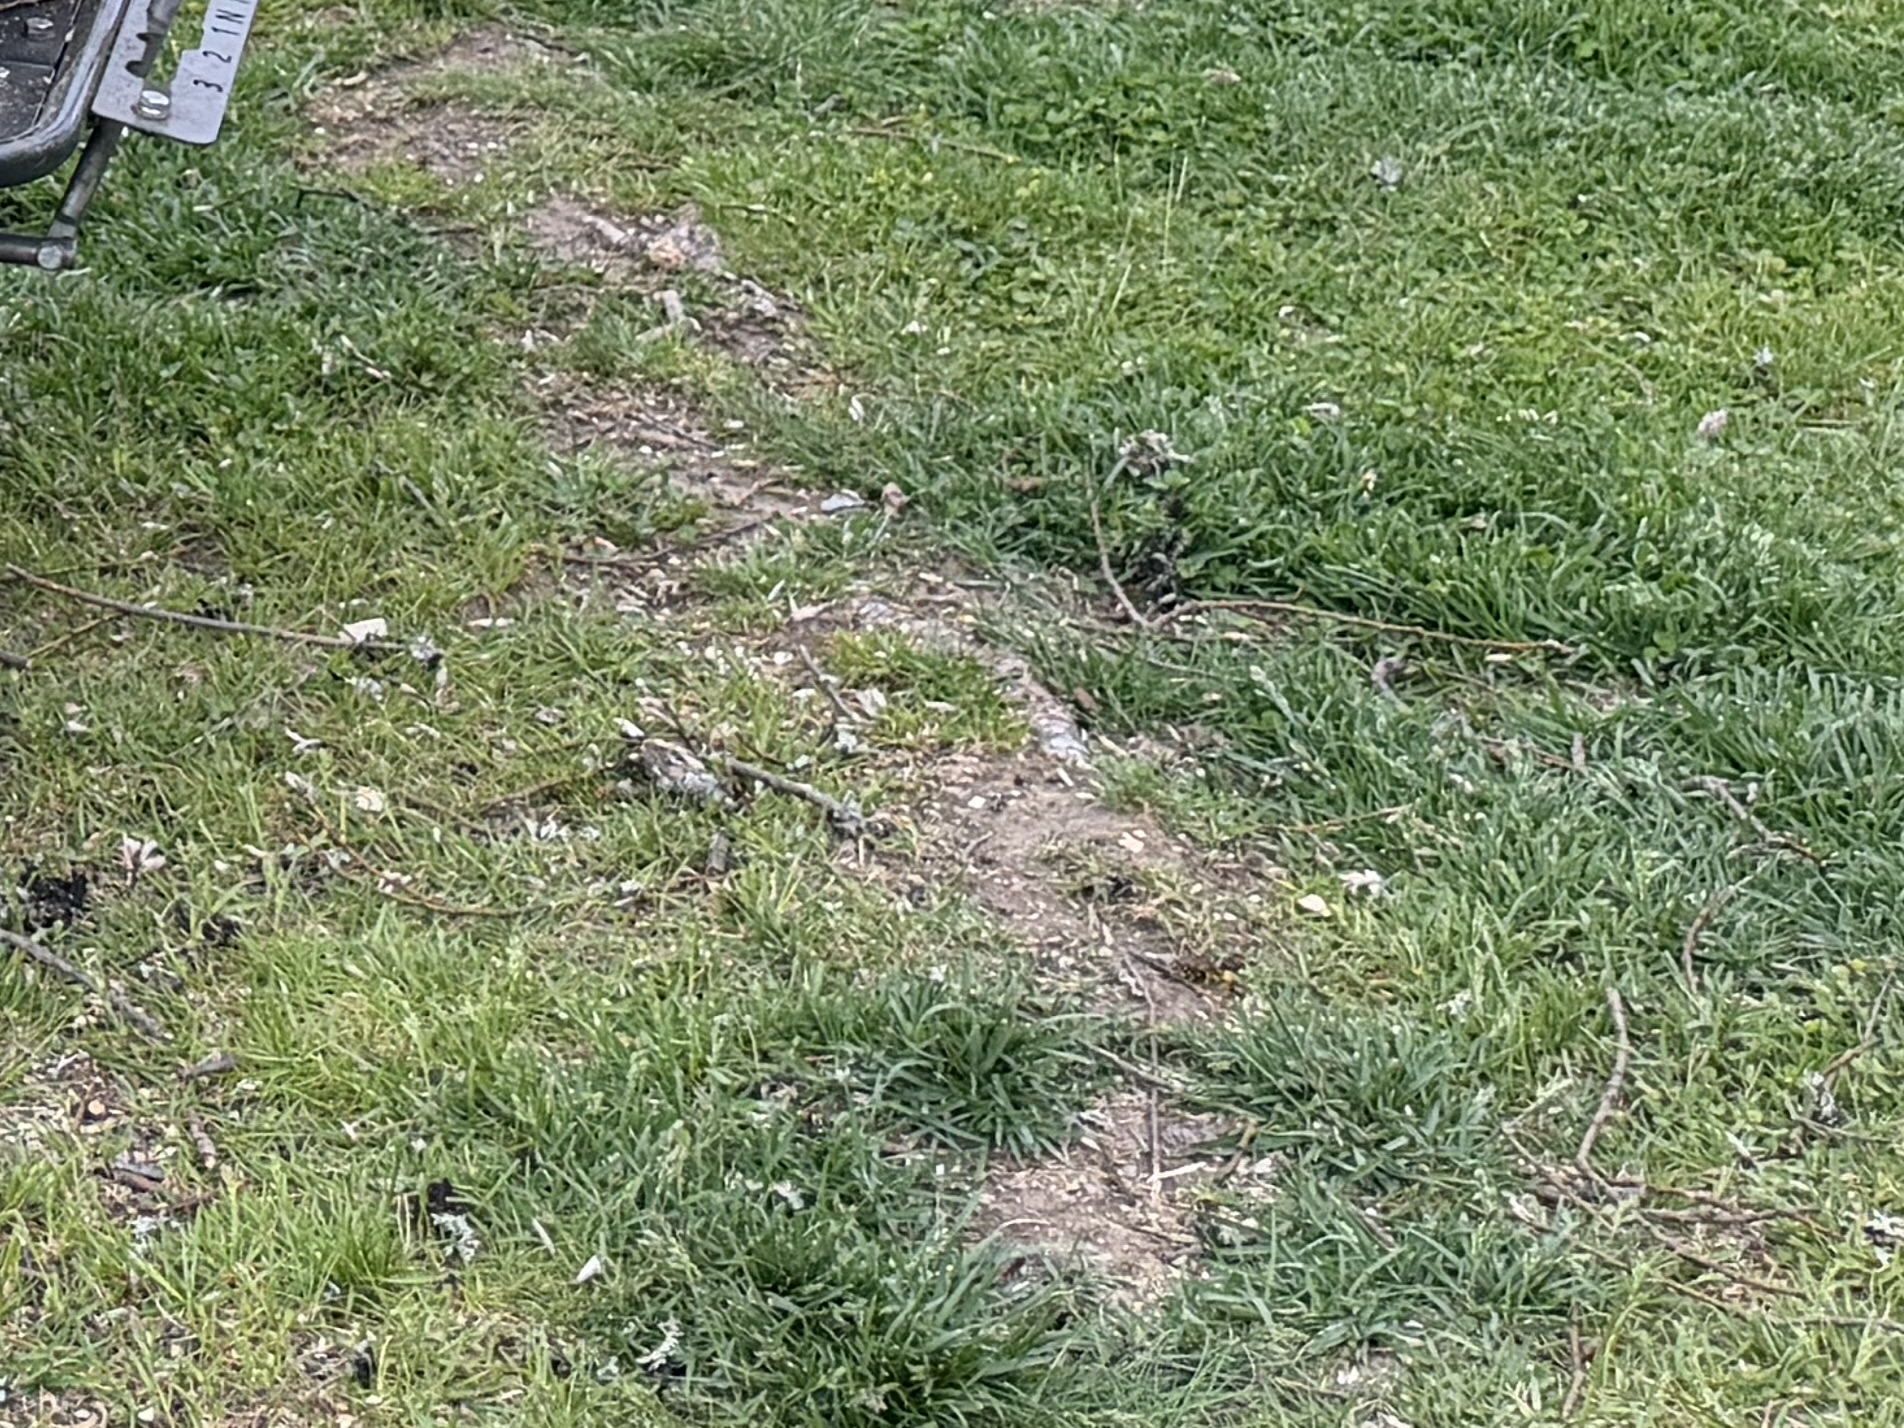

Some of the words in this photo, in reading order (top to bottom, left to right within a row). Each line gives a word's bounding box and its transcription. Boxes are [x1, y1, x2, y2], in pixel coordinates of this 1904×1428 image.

[215, 8, 246, 25] N
[211, 26, 241, 36] 1
[202, 50, 232, 63] 2
[193, 79, 223, 92] 3
